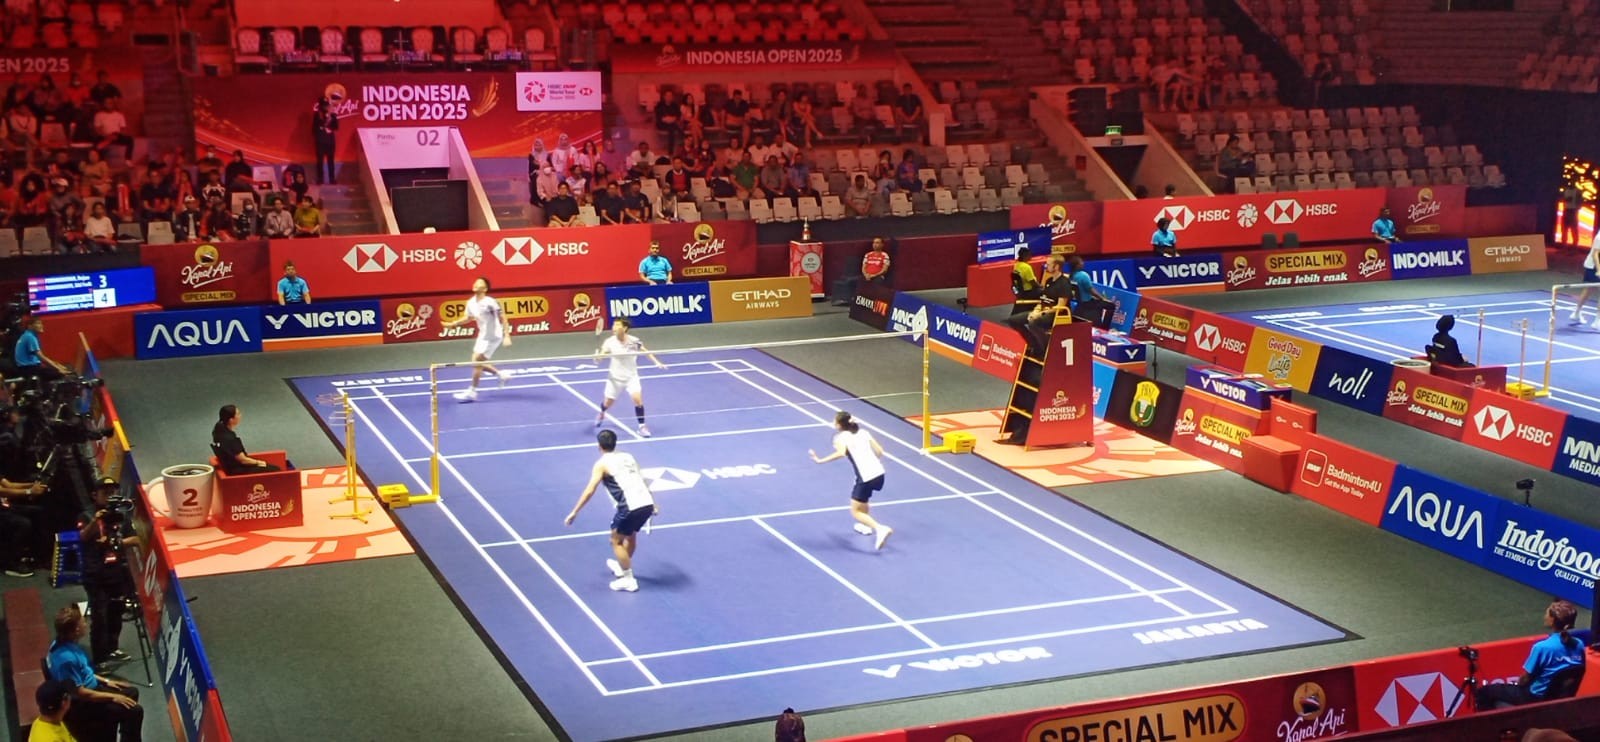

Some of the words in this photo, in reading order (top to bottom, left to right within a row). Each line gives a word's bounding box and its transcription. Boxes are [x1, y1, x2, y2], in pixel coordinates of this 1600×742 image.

[23, 57, 70, 72] 2025
[687, 50, 765, 65] INDONESIA
[768, 50, 806, 64] OPEN
[808, 49, 843, 63] 2025
[362, 84, 471, 103] INDONESIA
[363, 104, 417, 121] OPEN
[420, 103, 468, 120] 2025
[416, 129, 441, 147] 02
[1197, 208, 1231, 223] HSBC
[1306, 203, 1338, 216] HSBC
[402, 248, 447, 263] HSBC
[547, 242, 589, 256] HSBC
[706, 239, 726, 254] Api
[1484, 244, 1530, 256] ETIHAD
[1270, 253, 1321, 270] SPECIAL
[1323, 251, 1345, 265] MIX
[1393, 250, 1464, 270] INDOMILK
[181, 263, 215, 287] Kapal
[213, 261, 233, 280] Api
[1159, 261, 1220, 279] VICTOR
[1265, 275, 1292, 286] Jelas
[1294, 273, 1320, 284] lebih
[1323, 271, 1348, 282] enak
[99, 275, 107, 288] 3
[101, 293, 108, 304] 4
[184, 292, 216, 301] SPECIAL
[219, 291, 234, 299] MIX
[731, 288, 791, 301] ETIHAD
[517, 300, 545, 314] MIX
[610, 294, 703, 318] INDOMILK
[745, 300, 780, 309] AIRWAYS
[293, 309, 376, 329] VICTOR
[516, 320, 550, 333] enak
[891, 307, 914, 328] MNC
[148, 319, 250, 348] AQUA
[438, 326, 475, 339] Jelas
[945, 319, 977, 345] VICTOR
[1061, 338, 1074, 366] 1
[1092, 342, 1107, 356] TOR
[1221, 336, 1247, 355] HSBC
[1286, 341, 1302, 360] Day
[1211, 379, 1247, 402] VICTOR
[1415, 388, 1449, 408] SPECIAL
[1450, 399, 1467, 413] MIX
[1039, 405, 1077, 415] INDONESIA
[1039, 413, 1060, 422] OPEN
[1202, 417, 1233, 439] SPECIAL
[1516, 423, 1554, 447] HSBC
[1563, 436, 1600, 464] MN
[702, 463, 777, 480] HSBC
[1327, 463, 1382, 494] Badminton4U
[182, 488, 199, 507] 2
[231, 502, 281, 513] INDONESIA
[231, 512, 257, 521] OPEN
[258, 510, 280, 519] 2025
[1388, 485, 1484, 549] AQUA
[1581, 578, 1595, 589] FOO
[1133, 618, 1269, 645] JAKARTA
[908, 646, 1053, 672] VICTOR
[1182, 702, 1238, 738] MIX
[1277, 716, 1320, 742] Kapal
[1319, 708, 1346, 737] Api
